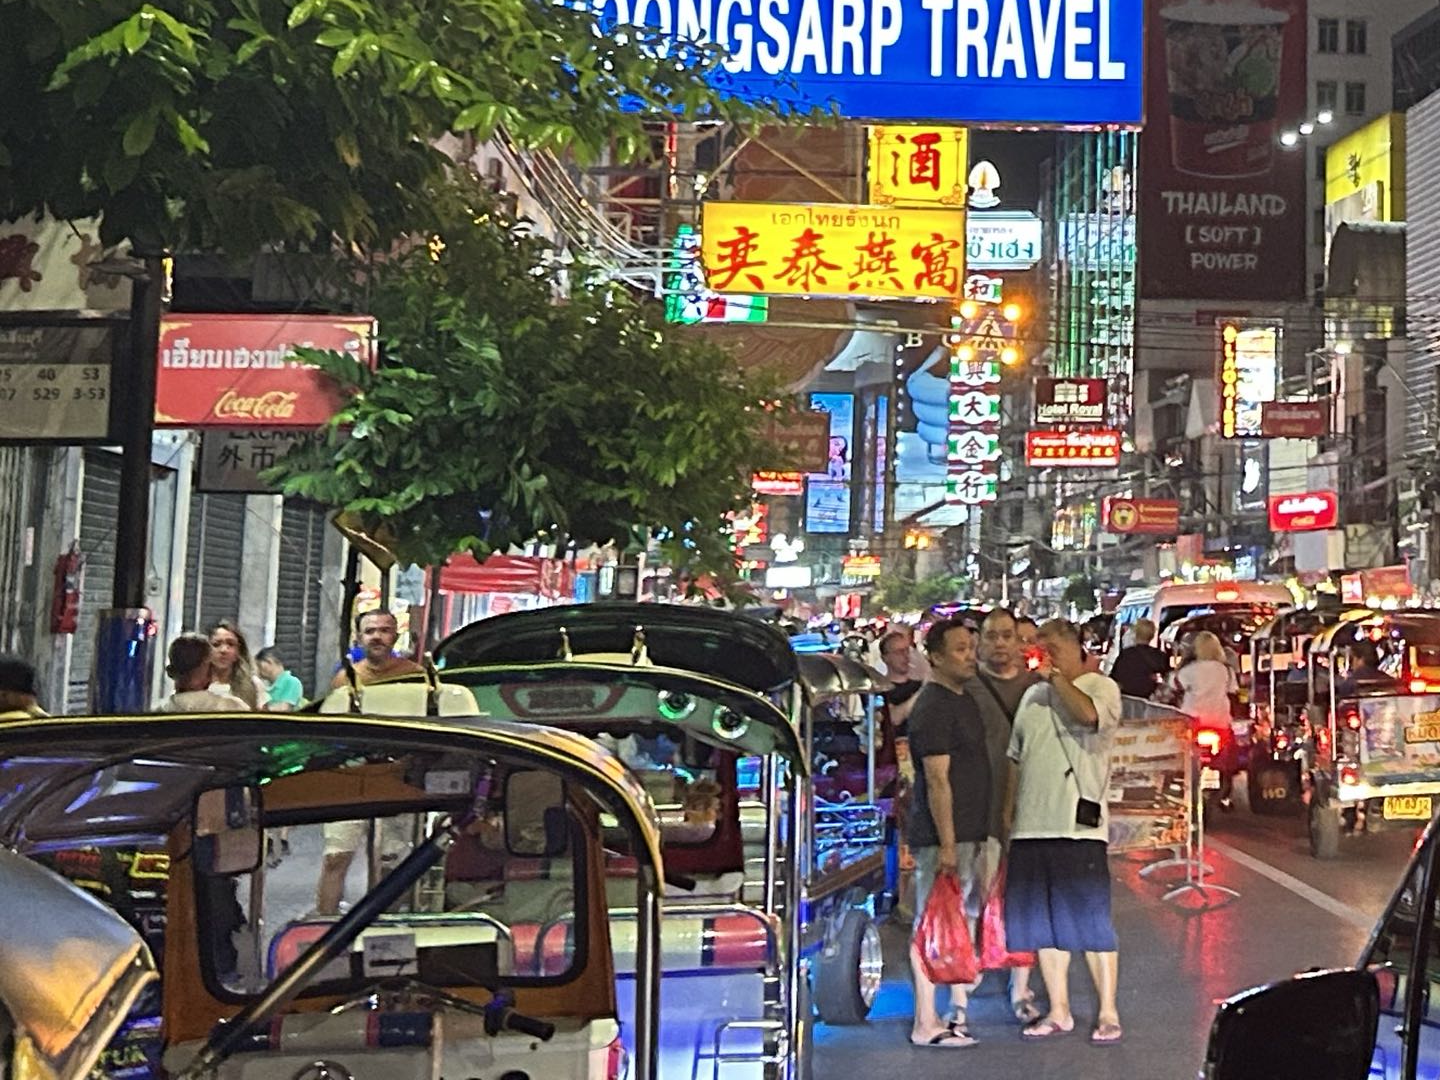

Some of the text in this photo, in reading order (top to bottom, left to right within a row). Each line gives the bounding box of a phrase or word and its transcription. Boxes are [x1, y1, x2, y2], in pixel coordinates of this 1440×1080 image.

[1160, 189, 1287, 217] THAILAND
[771, 207, 901, 230] เอกไทยรังนก
[1190, 251, 1258, 270] POWER
[82, 367, 100, 381] 53
[33, 387, 61, 401] 529
[73, 387, 106, 401] 3-53
